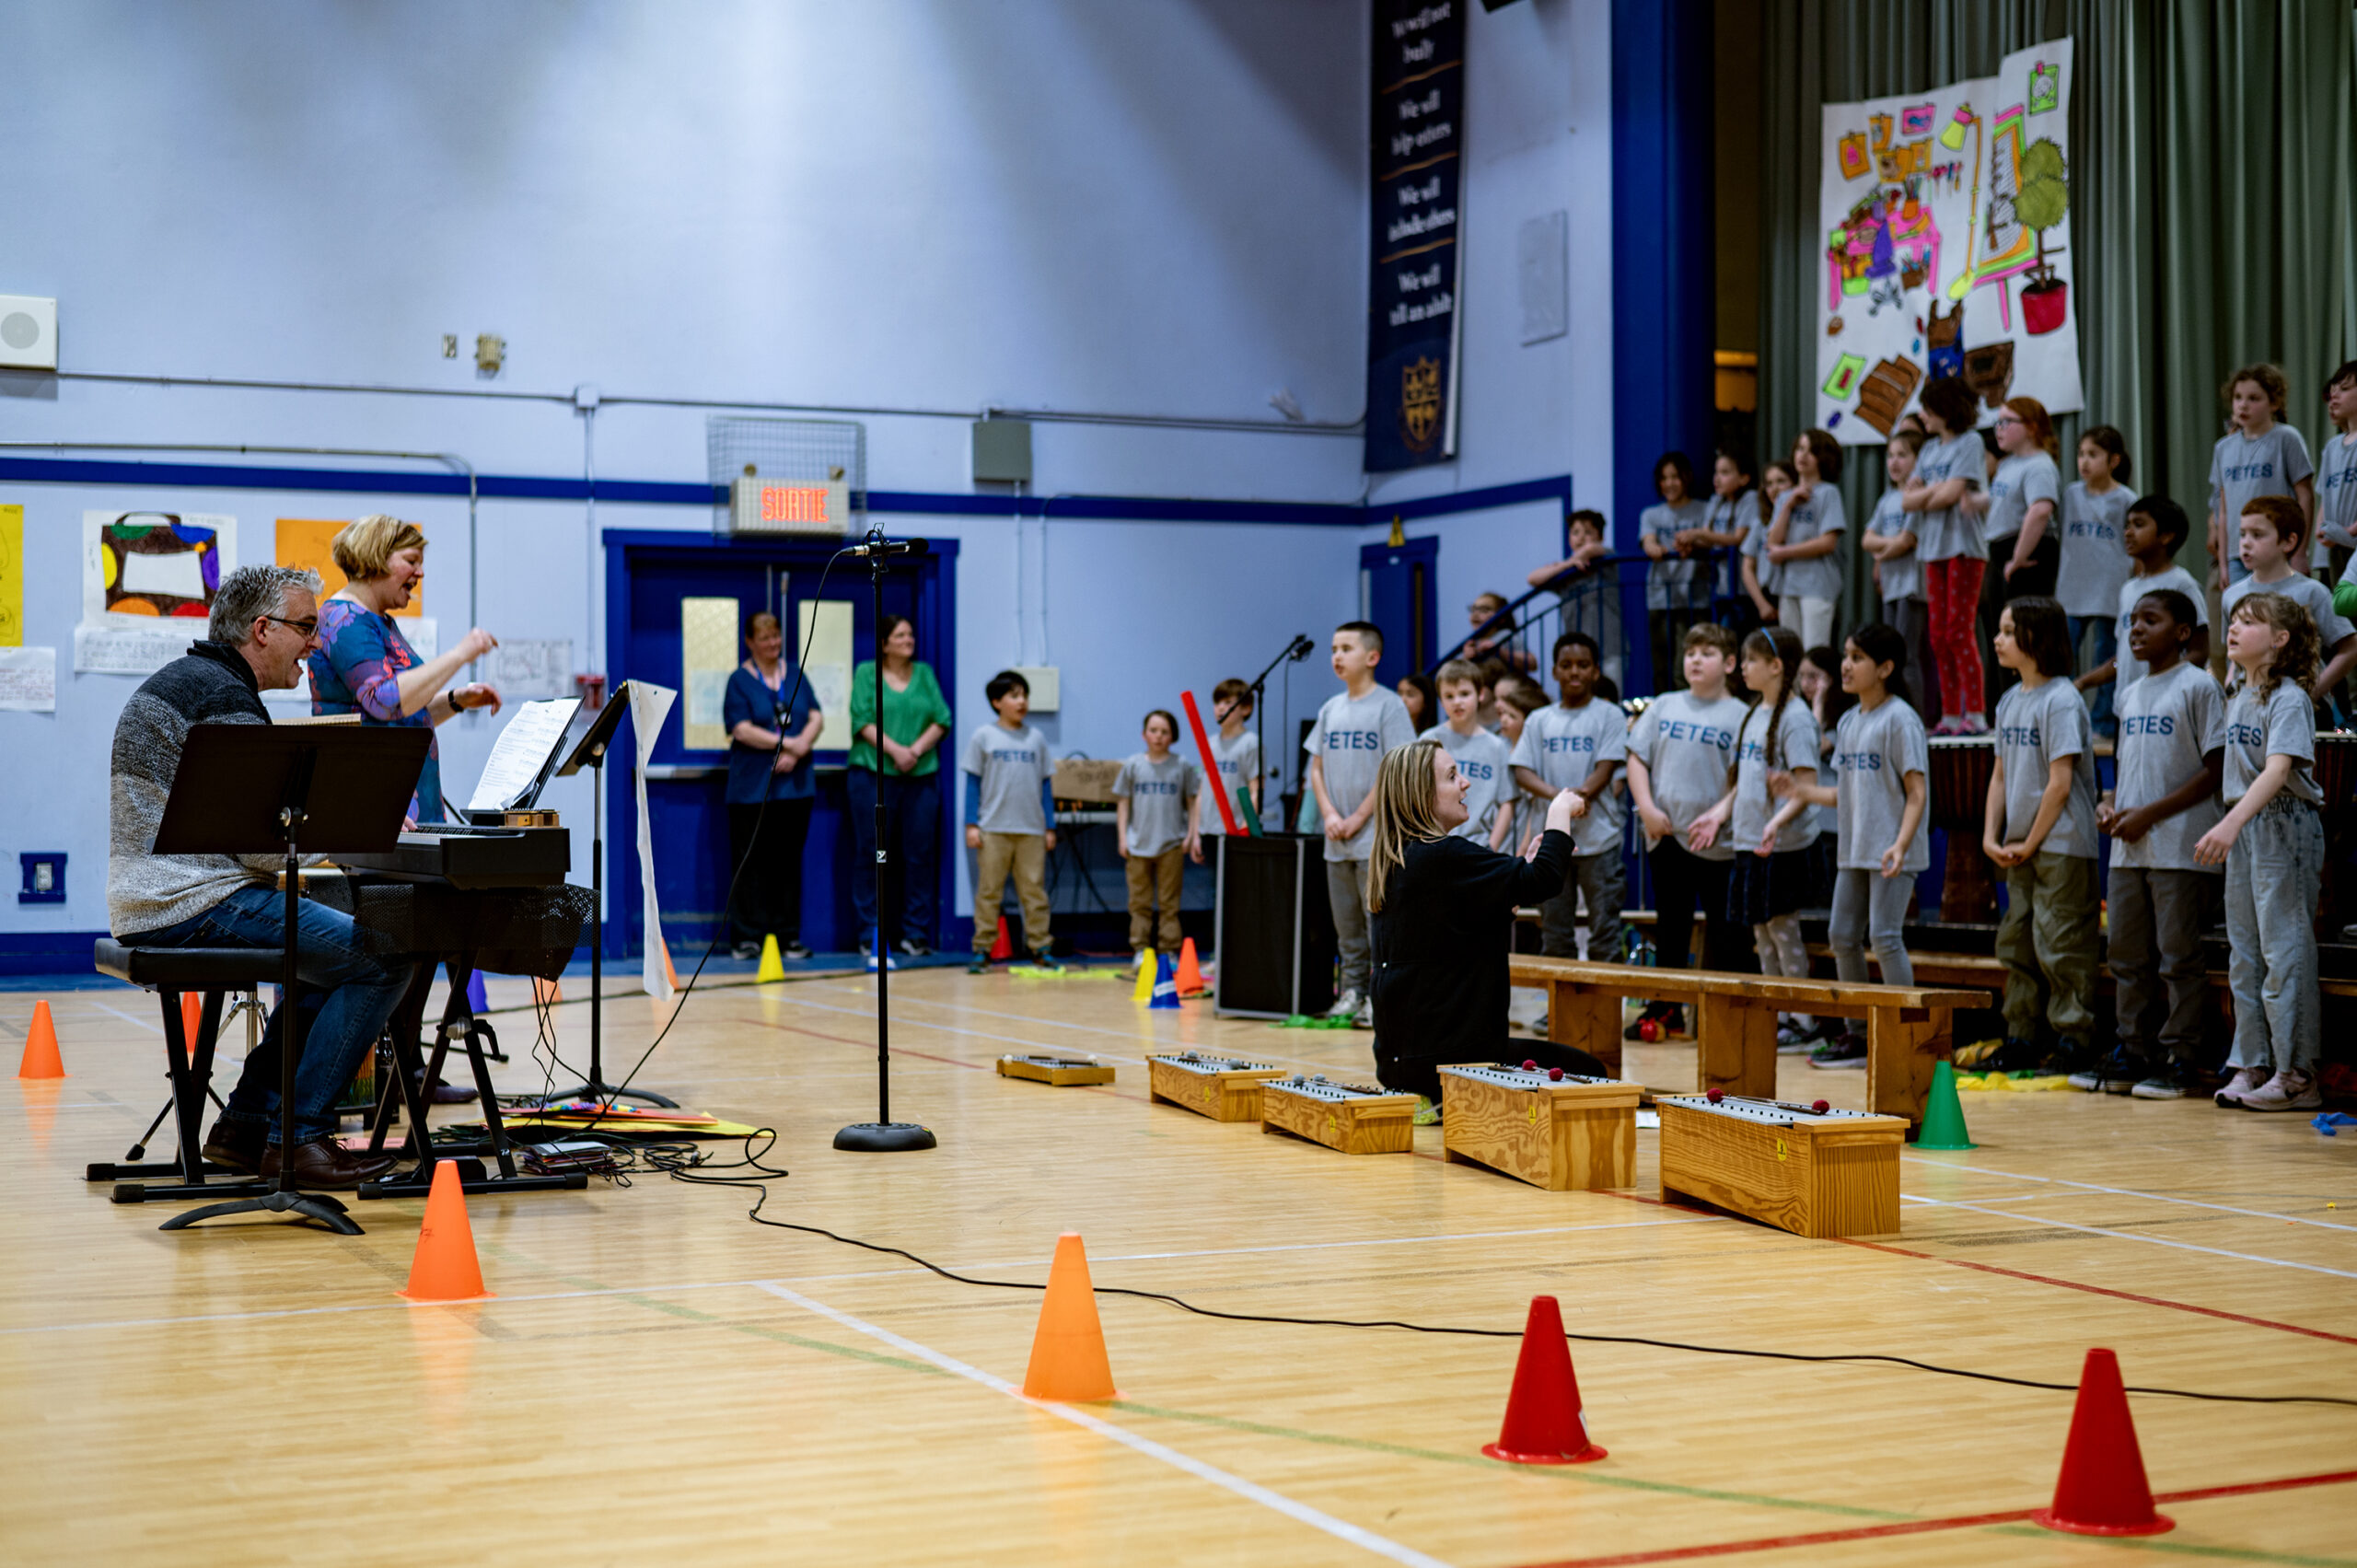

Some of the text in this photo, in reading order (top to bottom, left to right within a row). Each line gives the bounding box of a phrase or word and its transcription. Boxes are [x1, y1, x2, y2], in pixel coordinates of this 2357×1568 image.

[2224, 462, 2273, 482] PETES
[761, 486, 829, 524] SORTIE
[2069, 520, 2116, 540] PETES
[1660, 719, 1733, 750] PETES
[1455, 760, 1492, 781] TES
[1839, 752, 1882, 771] PETES
[1133, 782, 1178, 796] PETES
